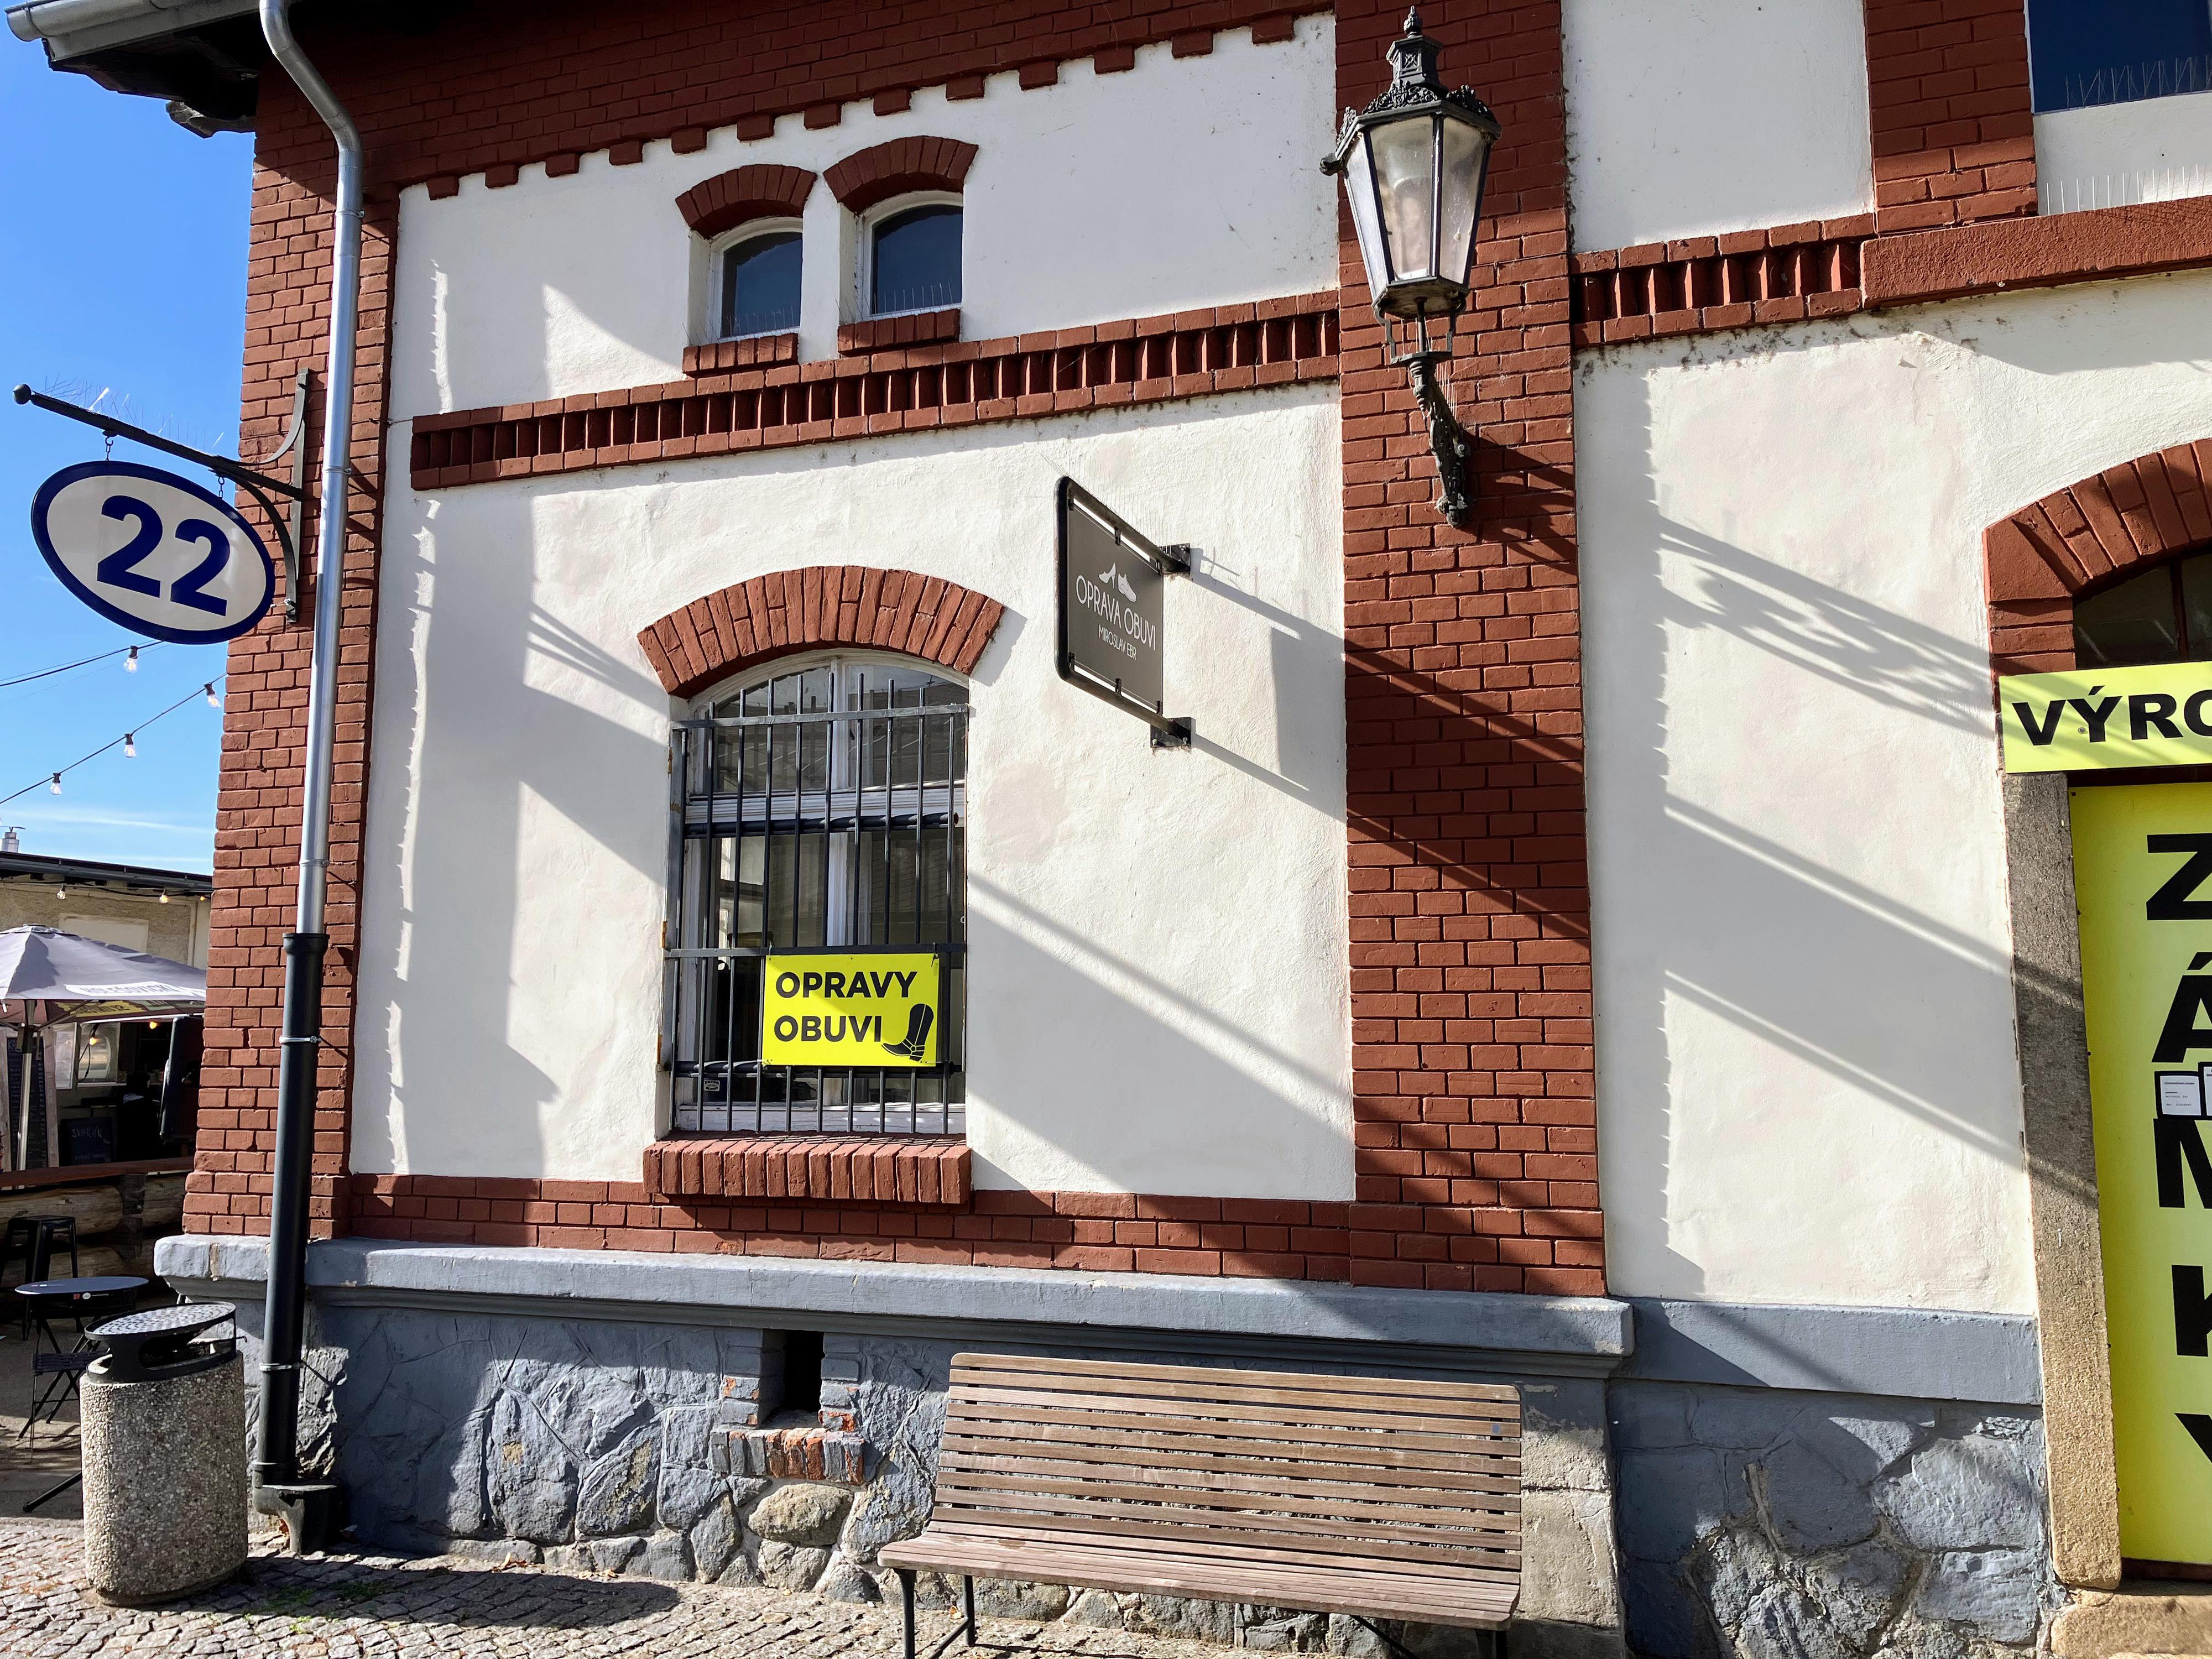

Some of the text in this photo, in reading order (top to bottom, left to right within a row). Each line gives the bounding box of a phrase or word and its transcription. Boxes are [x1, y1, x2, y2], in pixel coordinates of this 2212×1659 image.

[97, 495, 231, 617] 22
[1076, 575, 1156, 651] OPRAVA OBUVI
[1098, 624, 1137, 661] MIROSLAV EBR
[775, 971, 918, 998] OPRAVY
[774, 1015, 882, 1042] OBUVI
